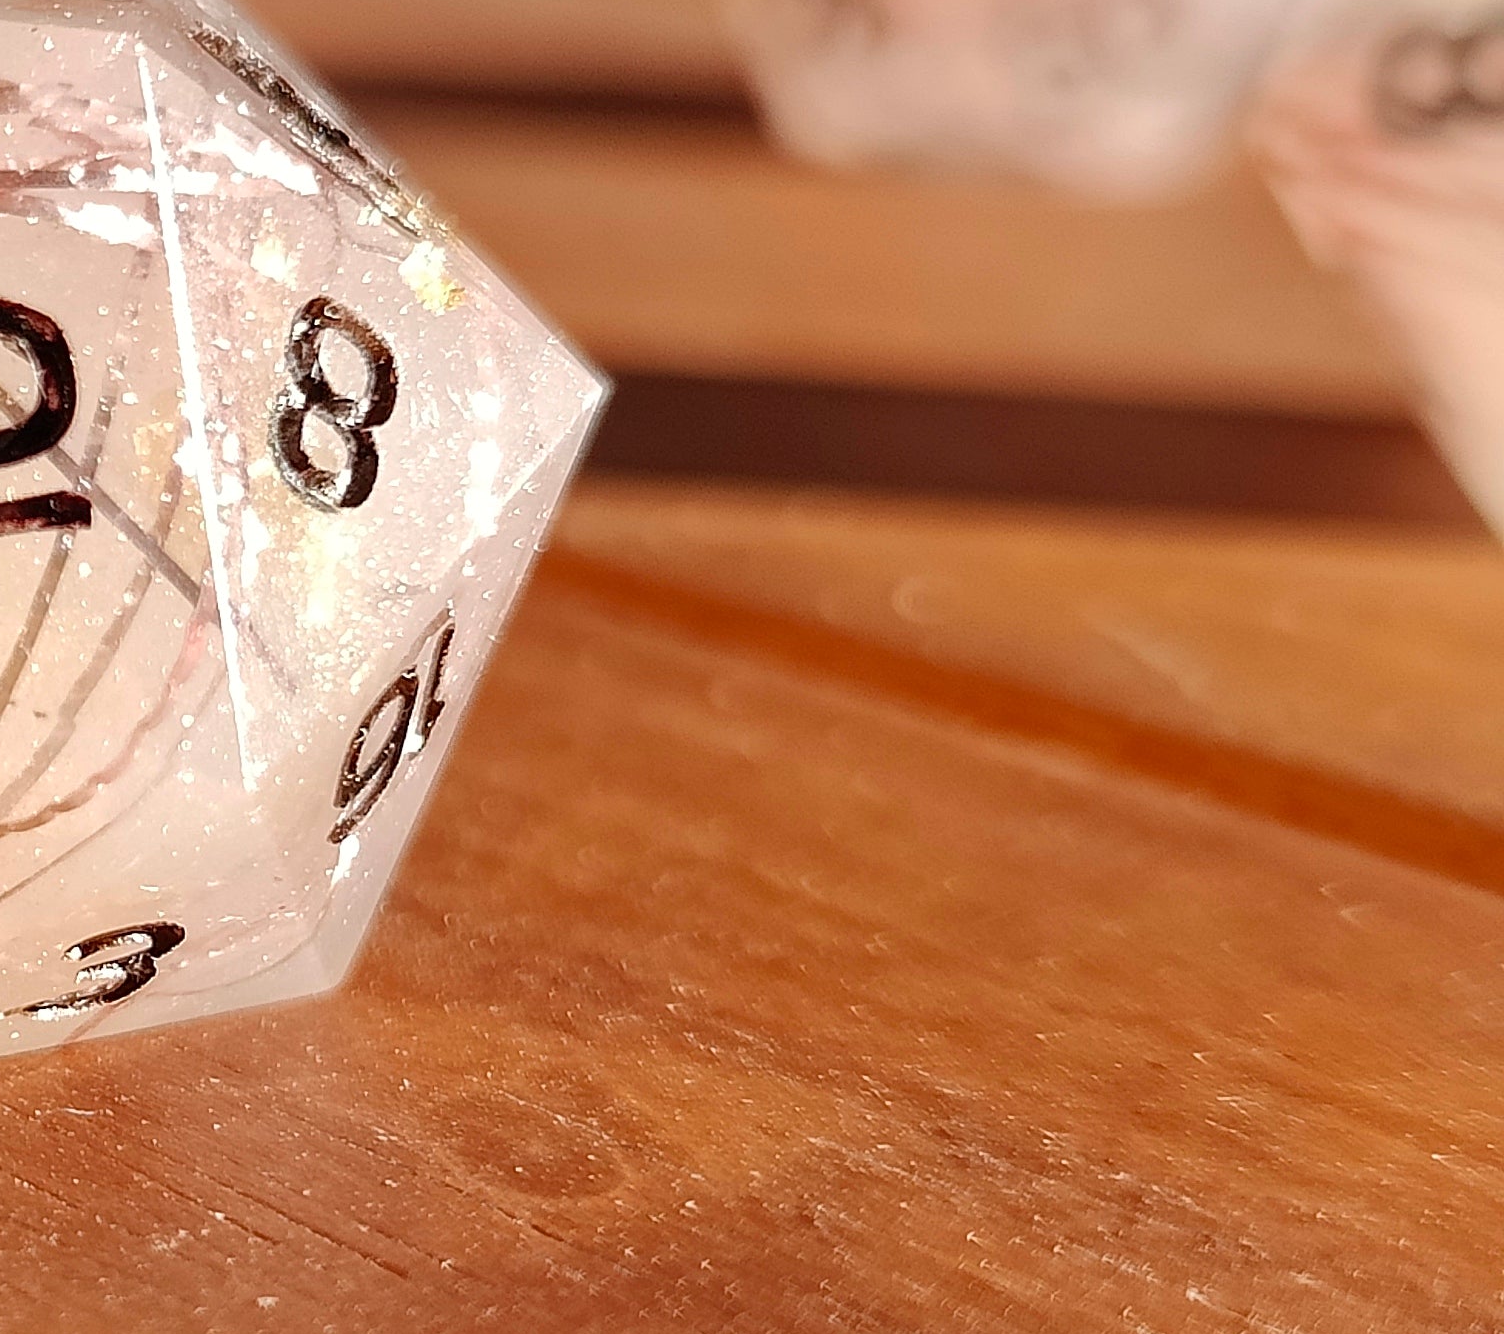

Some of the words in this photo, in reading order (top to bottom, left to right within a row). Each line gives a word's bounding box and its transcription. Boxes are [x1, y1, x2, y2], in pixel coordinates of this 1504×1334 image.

[268, 294, 398, 512] 8
[326, 620, 457, 845] 16
[21, 919, 186, 1021] 3
